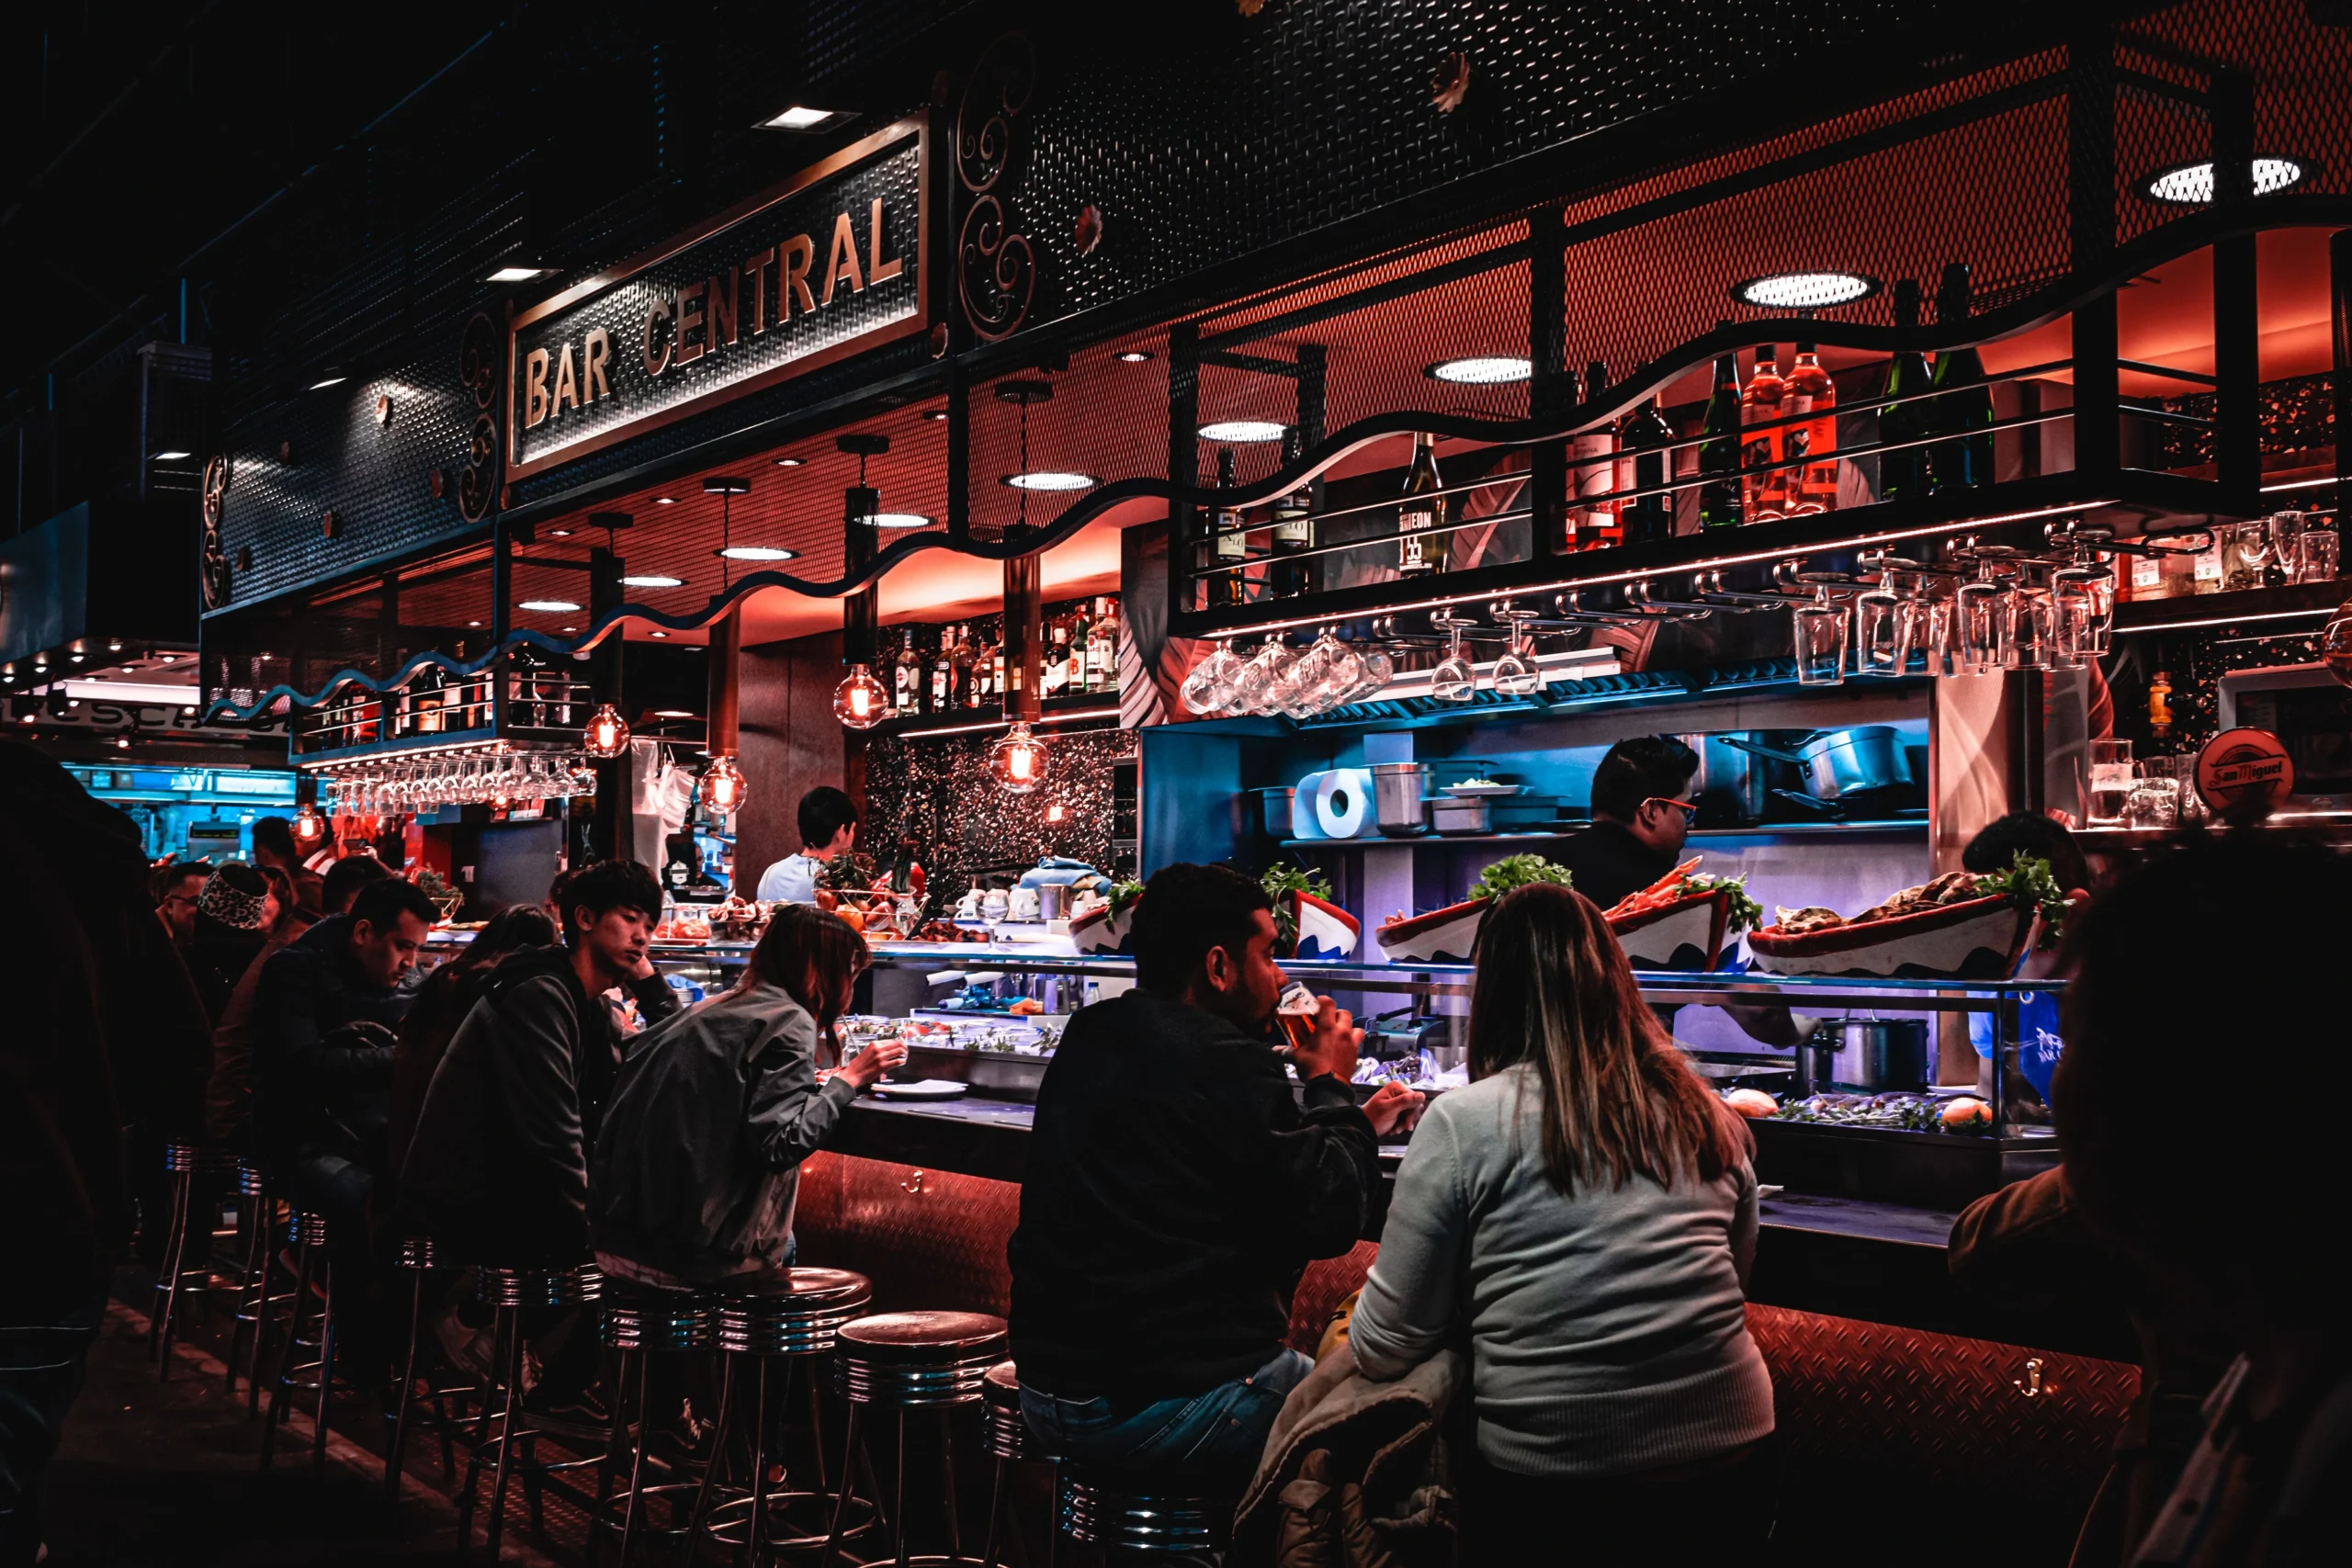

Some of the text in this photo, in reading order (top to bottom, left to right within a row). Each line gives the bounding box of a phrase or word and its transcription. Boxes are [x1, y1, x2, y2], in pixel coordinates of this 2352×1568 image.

[525, 197, 903, 430] BAR CENTRAL
[2208, 760, 2283, 787] San Miguel
